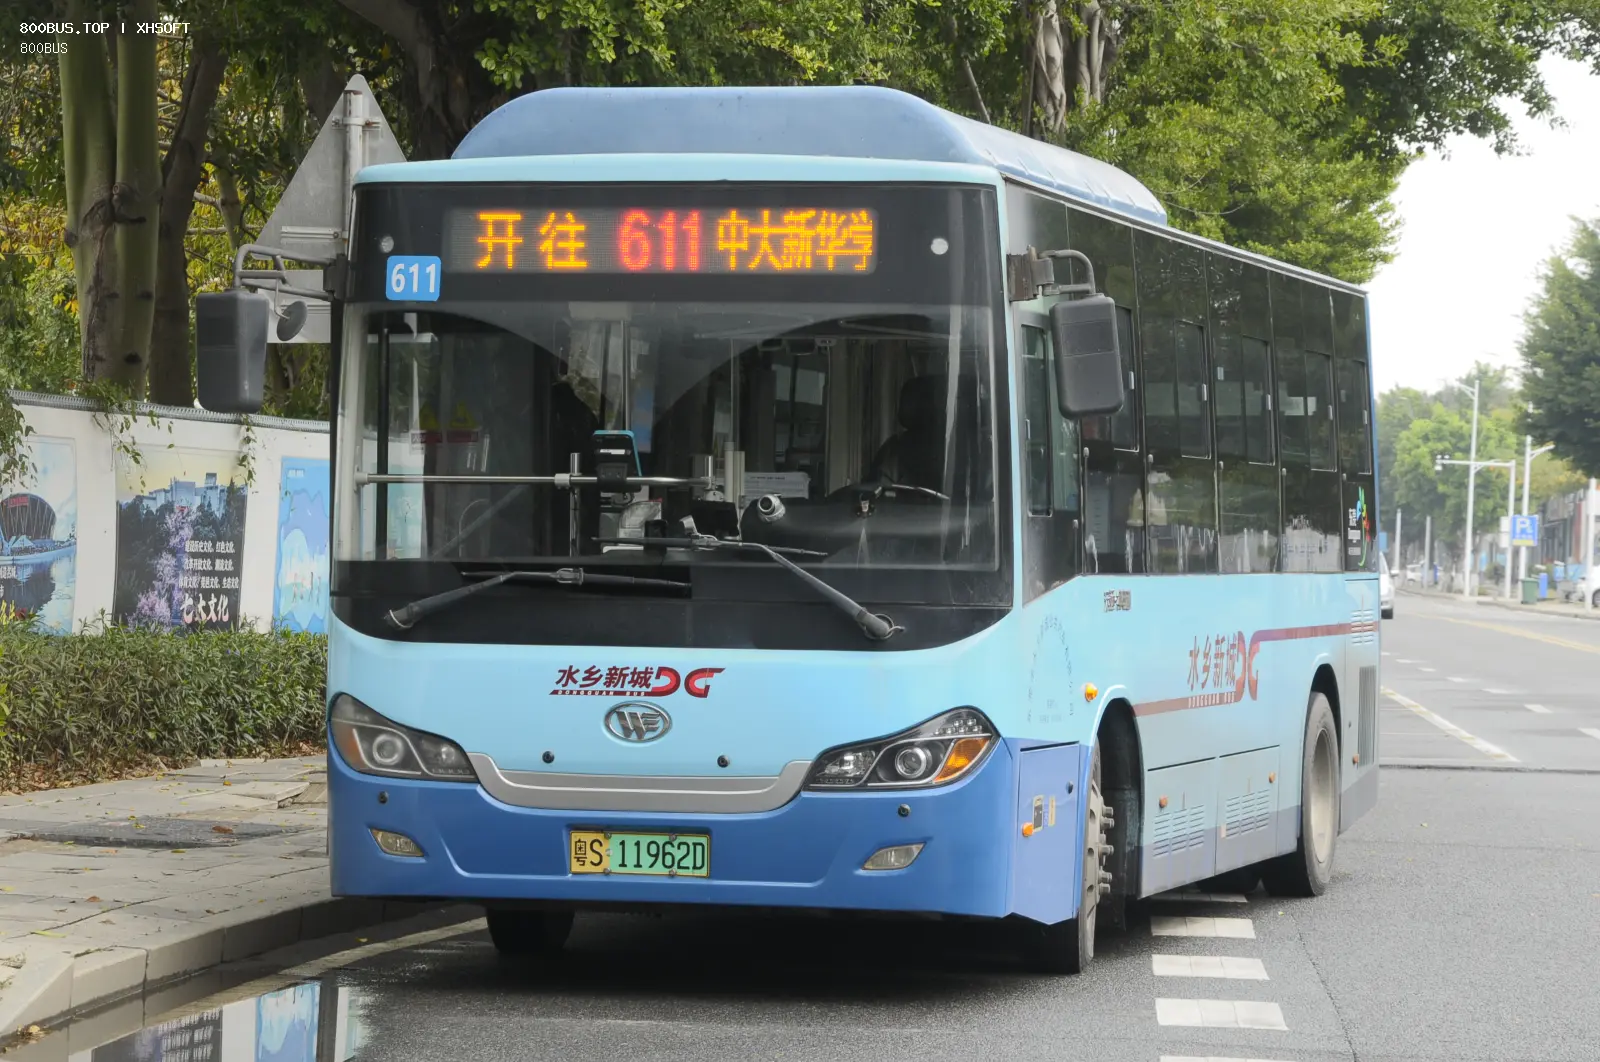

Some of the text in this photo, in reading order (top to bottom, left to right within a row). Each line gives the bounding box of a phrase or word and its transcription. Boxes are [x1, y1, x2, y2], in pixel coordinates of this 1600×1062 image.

[618, 209, 703, 271] 611
[390, 262, 437, 294] 611
[555, 664, 655, 689] 水乡新城
[1187, 632, 1237, 692] 水乡新城
[618, 839, 706, 871] 11962D
